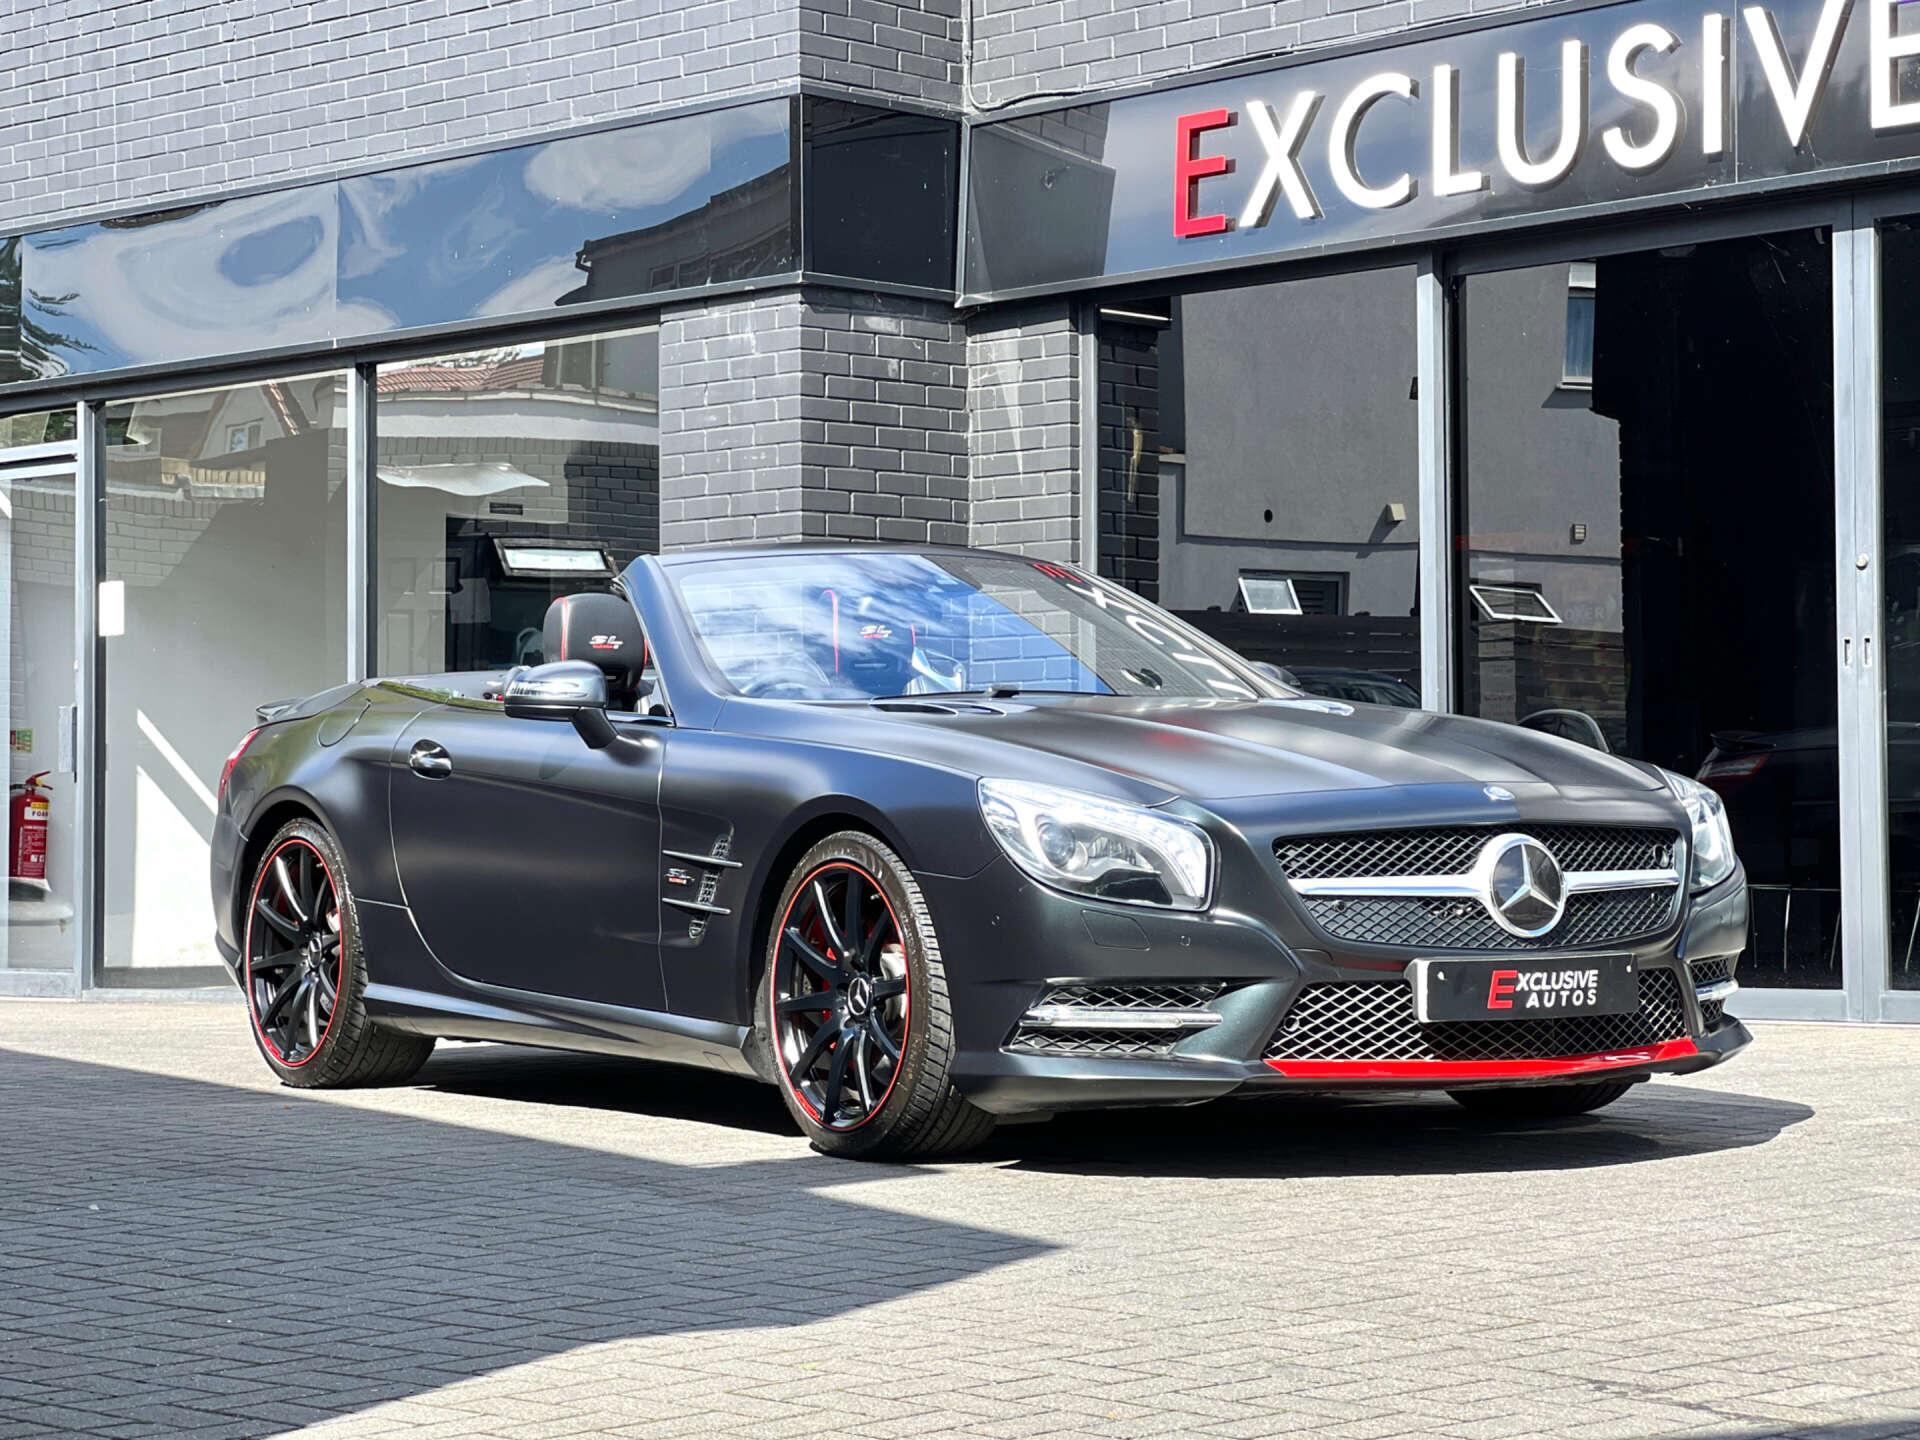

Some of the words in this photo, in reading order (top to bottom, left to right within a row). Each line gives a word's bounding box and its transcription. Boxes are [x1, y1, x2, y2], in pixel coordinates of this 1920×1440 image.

[1173, 0, 1920, 238] EXCLUSIVE
[1487, 969, 1599, 1009] EXCLUSIVE
[1525, 988, 1597, 1009] AUTOS
